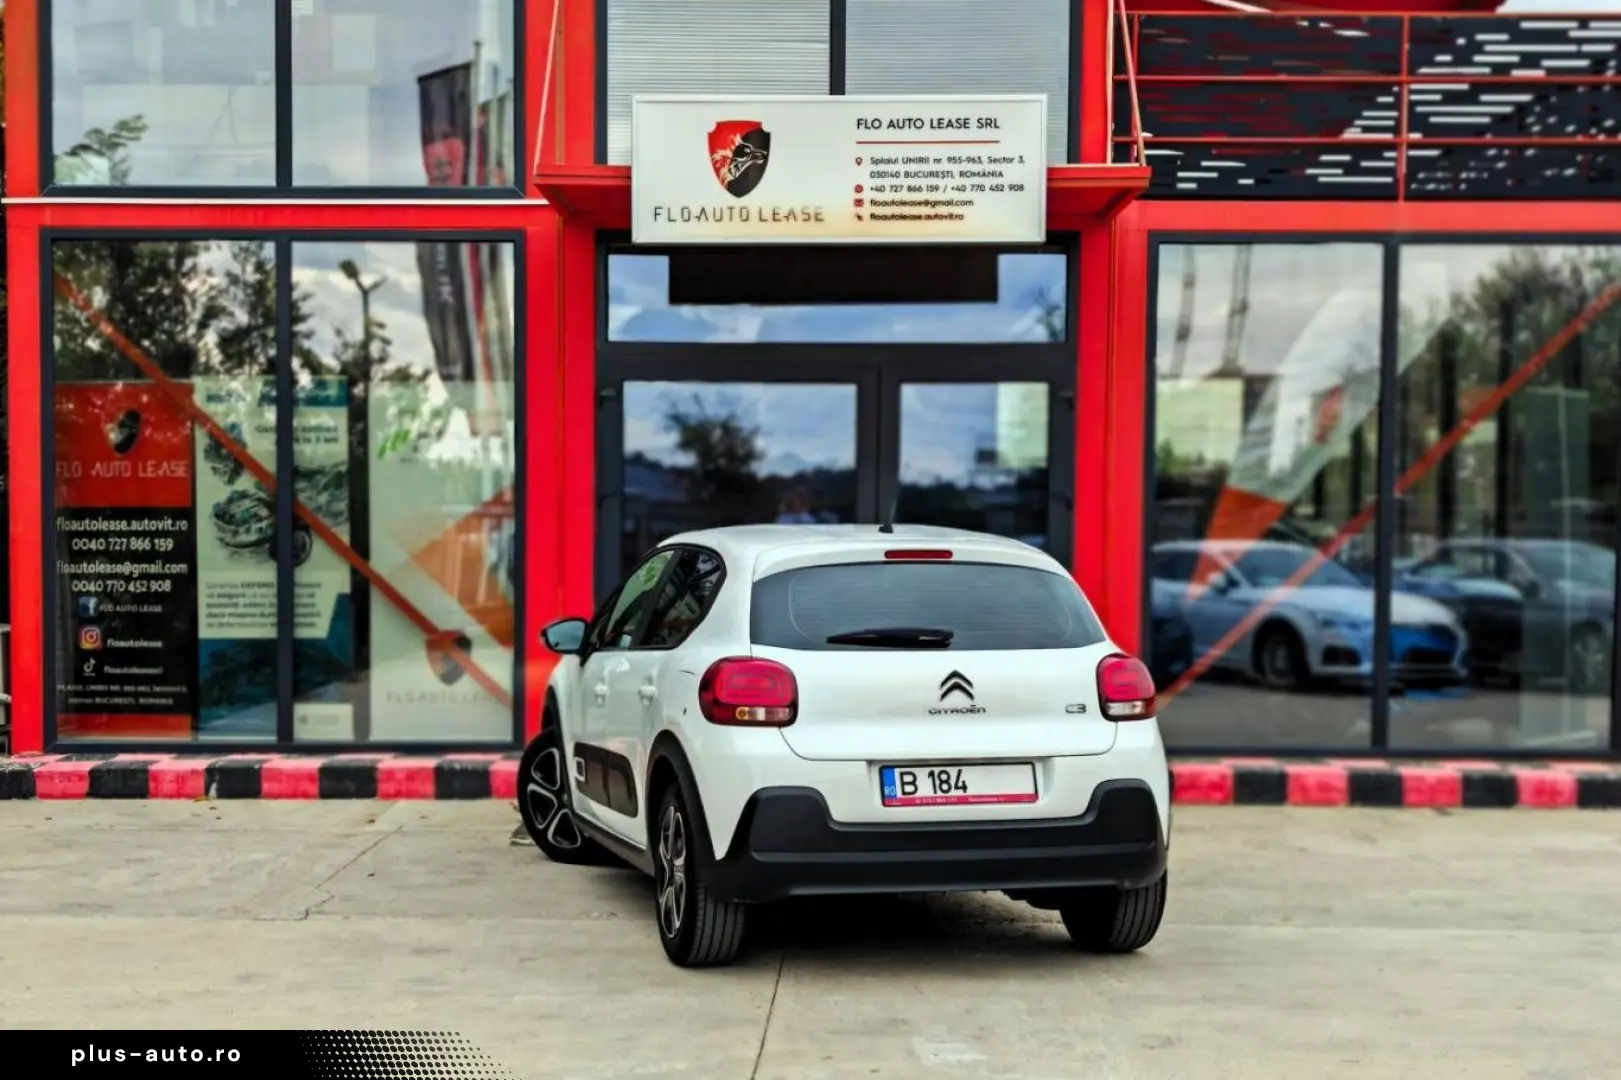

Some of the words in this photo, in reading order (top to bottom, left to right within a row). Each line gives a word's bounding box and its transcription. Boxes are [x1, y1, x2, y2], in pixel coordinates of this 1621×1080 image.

[856, 118, 882, 130] FLO
[887, 118, 925, 130] AUTO
[930, 118, 970, 130] LEASE
[976, 118, 1000, 130] SRL
[869, 156, 899, 166] Splaiul
[987, 156, 1014, 165] Sector
[870, 184, 886, 193] +40
[889, 184, 904, 193] 727
[907, 184, 923, 193] 866
[926, 184, 940, 193] 159
[951, 184, 966, 193] +40
[970, 184, 986, 193] 770
[989, 184, 1004, 193] 452
[1008, 184, 1024, 193] 908
[869, 199, 974, 209] floautolease@gmail.com
[654, 206, 692, 222] FLO
[758, 206, 825, 222] LEASE
[869, 213, 965, 221] floautolease.autovit.ro
[138, 460, 188, 478] LEASE
[56, 516, 189, 532] floautolease.autovit.ro
[72, 538, 106, 551] 0040
[108, 538, 127, 551] 727
[129, 537, 151, 552] 866
[154, 538, 174, 551] 159
[56, 560, 188, 577] floautolease@gmail.com
[71, 580, 104, 592] 0040
[106, 580, 126, 592] 770
[127, 580, 148, 592] 452
[149, 580, 172, 592] 908
[1065, 703, 1087, 714] C3
[900, 771, 918, 796] B
[928, 769, 968, 794] 184
[884, 786, 896, 797] RO
